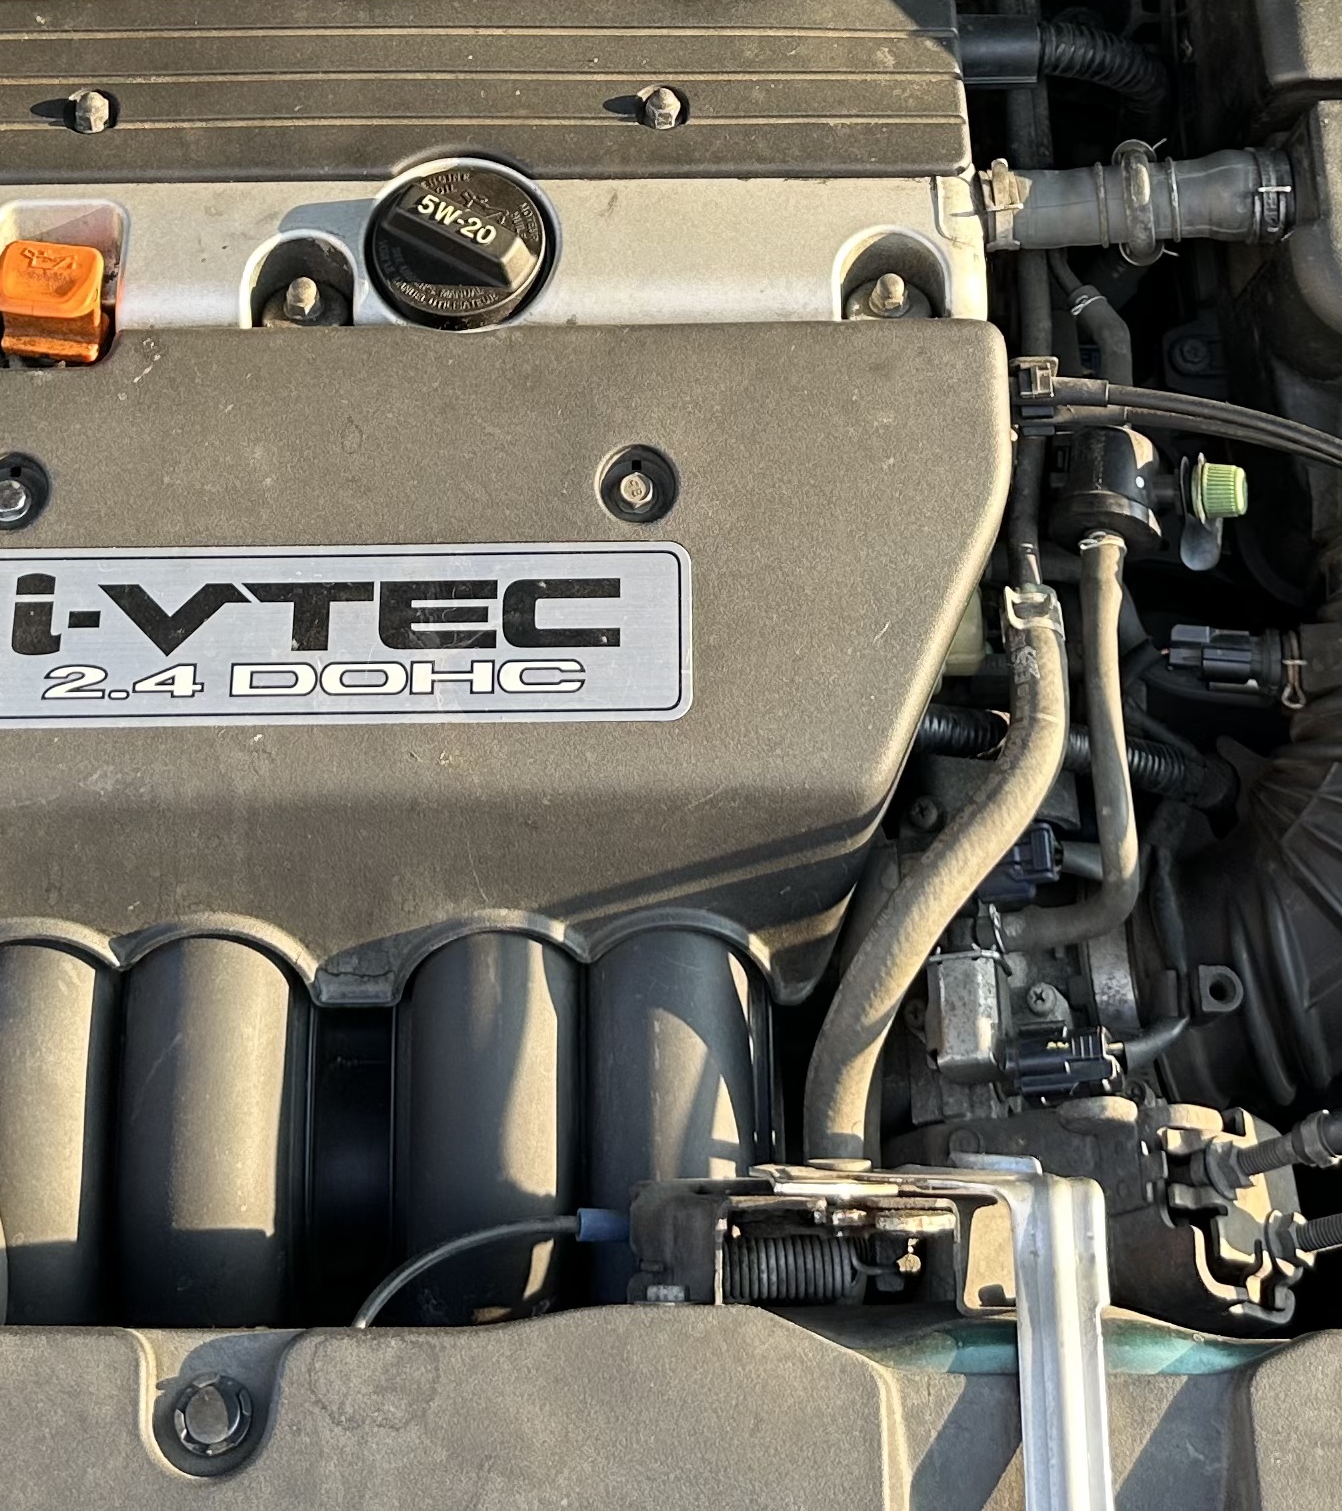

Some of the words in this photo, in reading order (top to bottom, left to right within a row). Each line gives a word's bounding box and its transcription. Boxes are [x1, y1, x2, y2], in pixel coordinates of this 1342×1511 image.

[417, 194, 497, 244] 5W-20
[9, 572, 622, 657] i-VTEC
[40, 662, 205, 701] 2.4
[228, 658, 587, 698] DOHC
